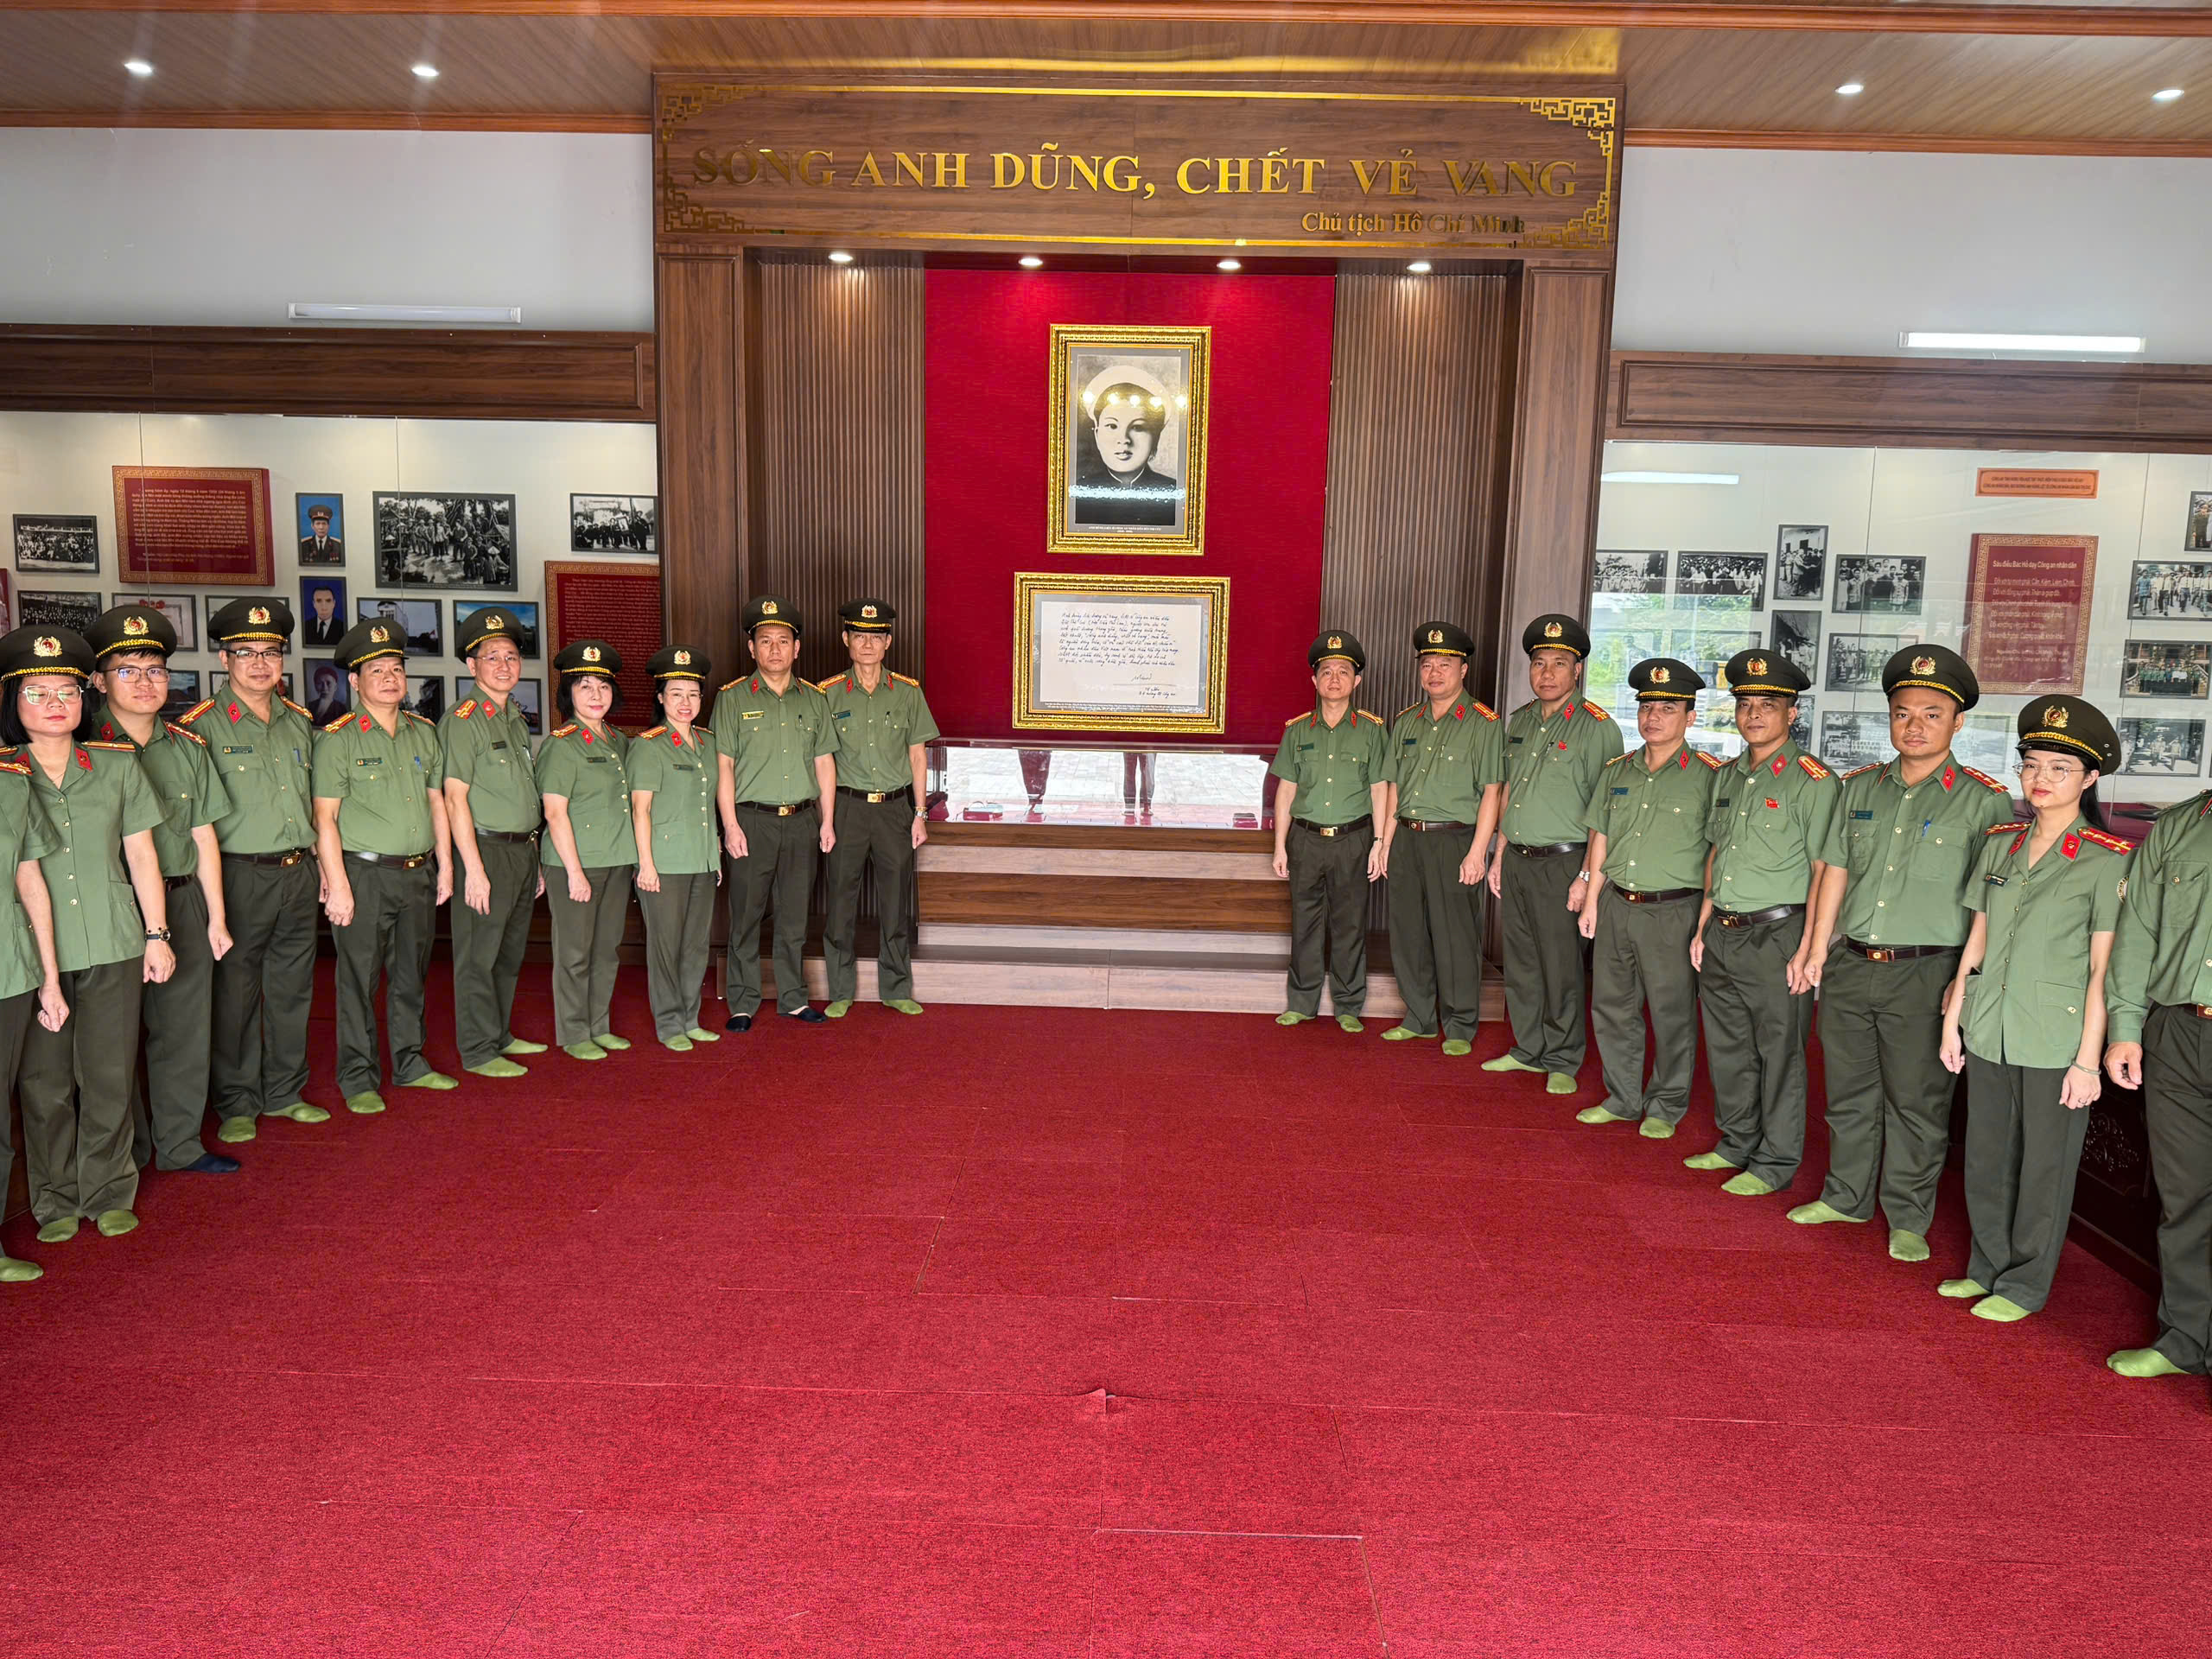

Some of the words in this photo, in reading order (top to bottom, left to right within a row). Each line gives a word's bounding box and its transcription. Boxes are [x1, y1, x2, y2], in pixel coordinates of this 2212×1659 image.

[694, 137, 836, 188] SỐNG
[851, 151, 970, 188] ANH
[990, 142, 1156, 200] DŨNG,
[1176, 147, 1325, 195] CHẾT
[1349, 148, 1418, 196] VẺ
[1442, 159, 1577, 198] VANG
[1301, 212, 1341, 232] Chủ
[1348, 213, 1385, 237] tịch
[1392, 210, 1423, 233] Hồ
[1429, 213, 1466, 233] Chí
[1471, 214, 1525, 234] Minh
